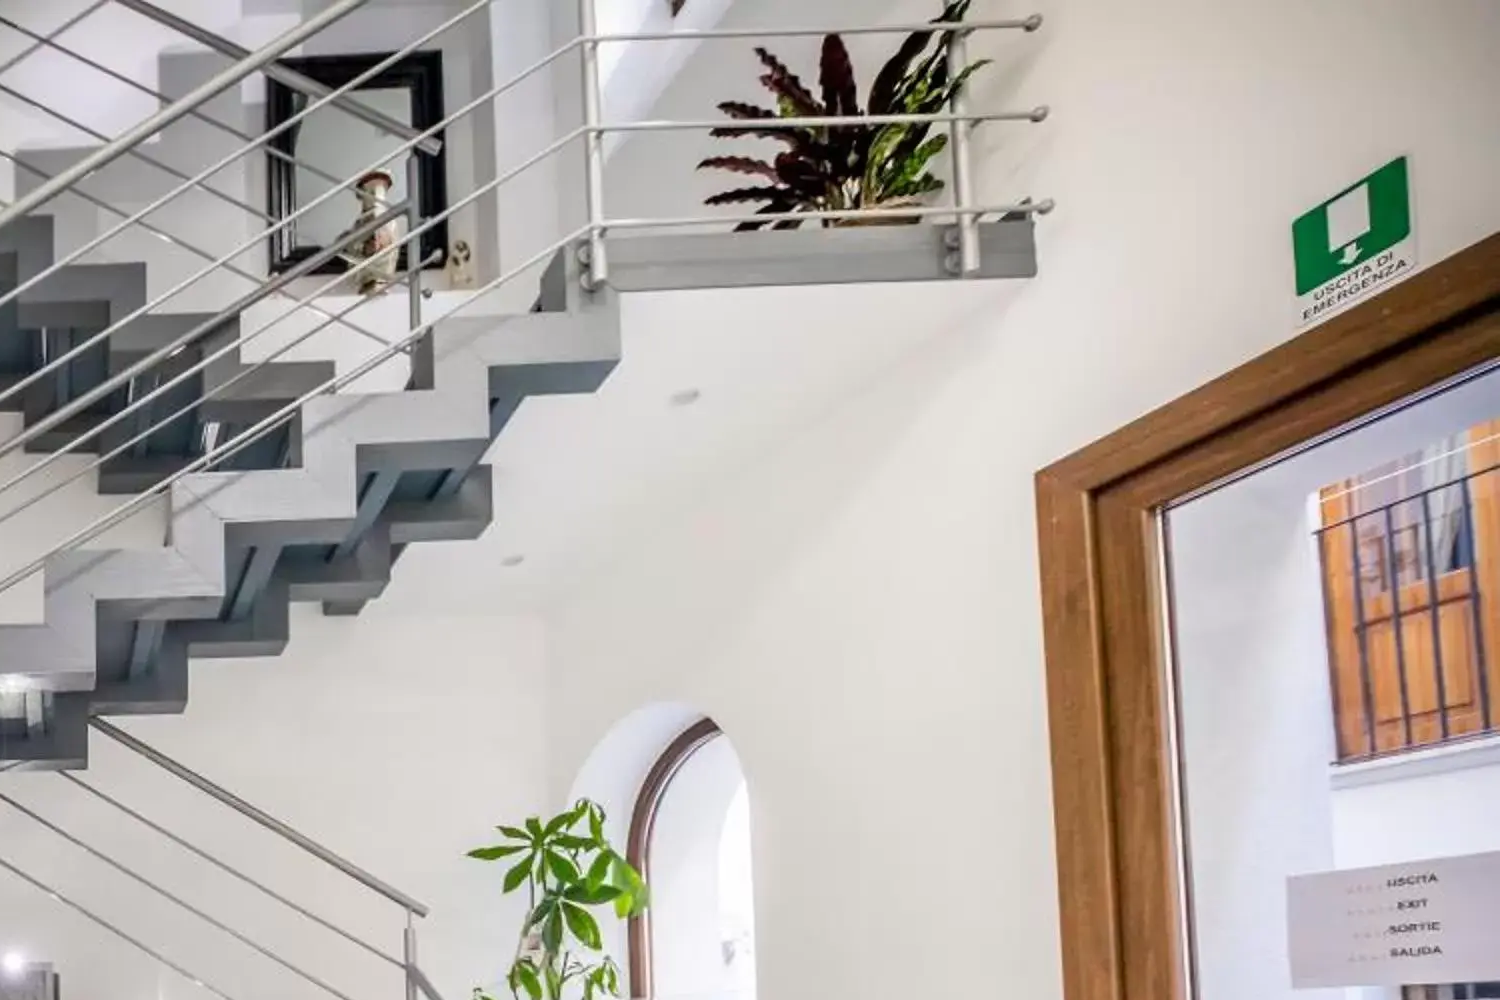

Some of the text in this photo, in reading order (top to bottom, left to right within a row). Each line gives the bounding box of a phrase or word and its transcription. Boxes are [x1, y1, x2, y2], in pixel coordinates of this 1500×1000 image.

[1313, 252, 1393, 300] USCITA DI
[1303, 259, 1406, 319] EMERGENZA
[1387, 873, 1438, 887] USCITA
[1397, 899, 1428, 910] EXIT
[1389, 922, 1440, 934] SORTIE
[1390, 946, 1442, 957] SALIDA
